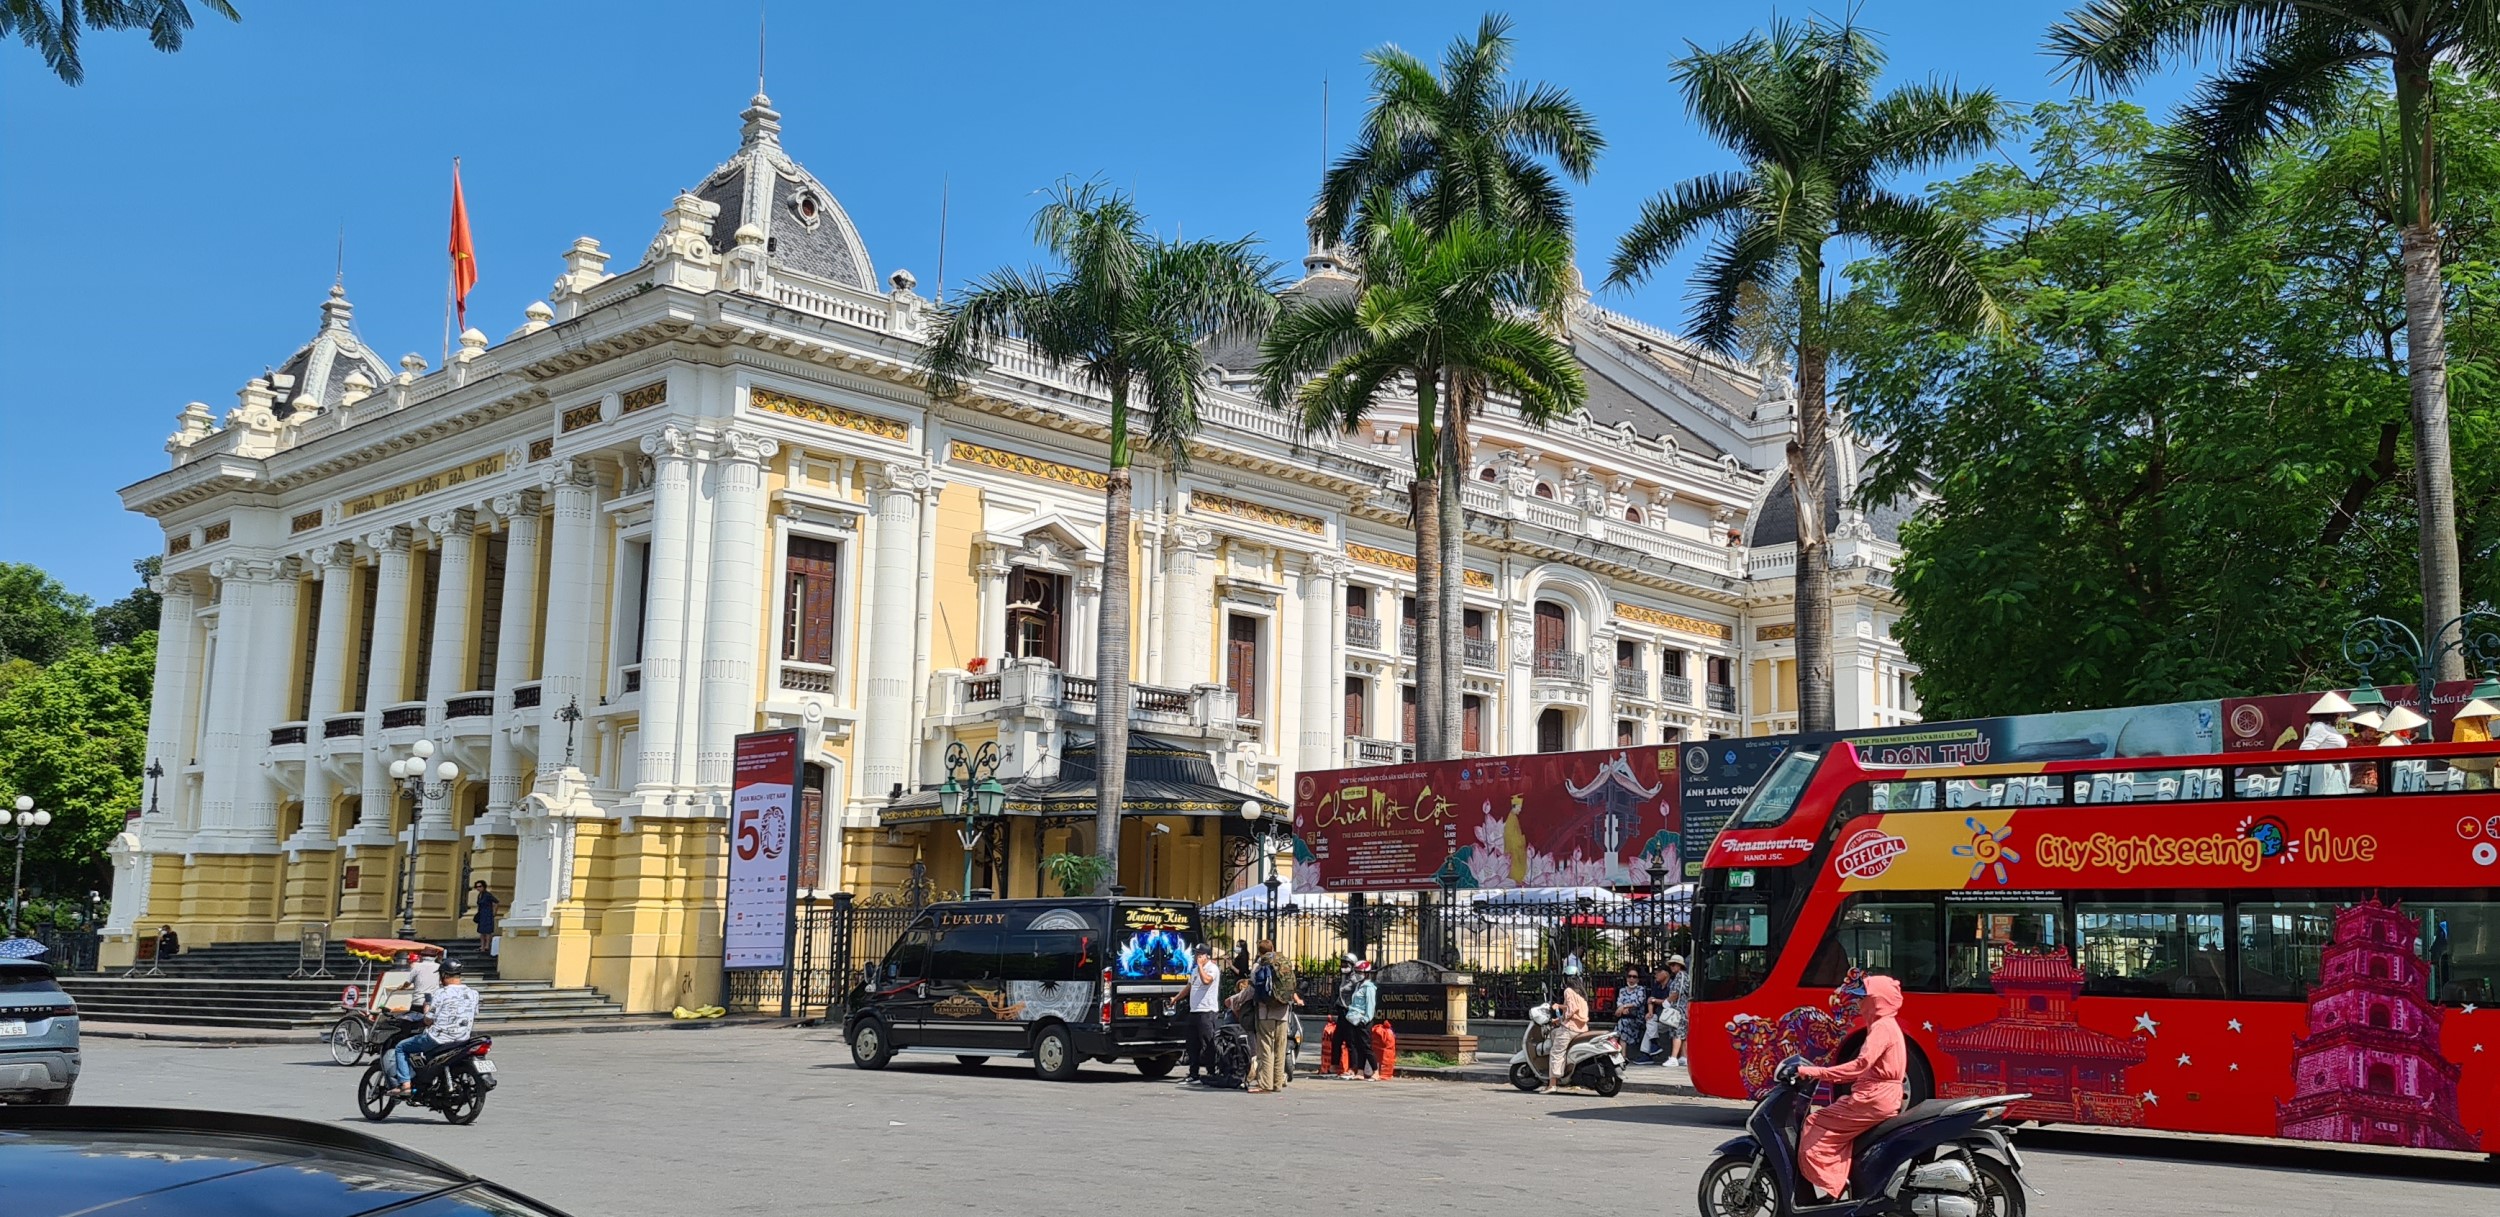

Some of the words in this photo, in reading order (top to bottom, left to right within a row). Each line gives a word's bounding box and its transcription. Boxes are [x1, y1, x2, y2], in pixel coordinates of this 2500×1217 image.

[353, 495, 376, 515] NHÀ
[384, 487, 407, 505] HÁT
[415, 477, 440, 496] LỚN
[449, 466, 466, 485] HÀ
[475, 458, 498, 478] NỘI
[1939, 732, 1990, 763] THỨ
[1706, 785, 1729, 796] SÁNG
[1315, 789, 1368, 828] Chùa
[1371, 788, 1411, 828] Một
[1414, 785, 1459, 826] Cột
[736, 805, 786, 860] 50
[1743, 854, 1766, 862] HANOI
[1768, 853, 1784, 861] JSC.
[1843, 840, 1902, 871] OFFICIAL
[2035, 832, 2261, 873] CitySightseeing
[2304, 828, 2377, 863] Hue
[1863, 859, 1890, 875] TOUR
[942, 913, 1005, 925] LUXURY
[1125, 910, 1162, 925] Hương
[1382, 991, 1403, 1002] QUẢNG
[1405, 992, 1429, 1002] TRƯỜNG
[1406, 1007, 1428, 1020] THÁNG
[1429, 1007, 1444, 1021] TÁM
